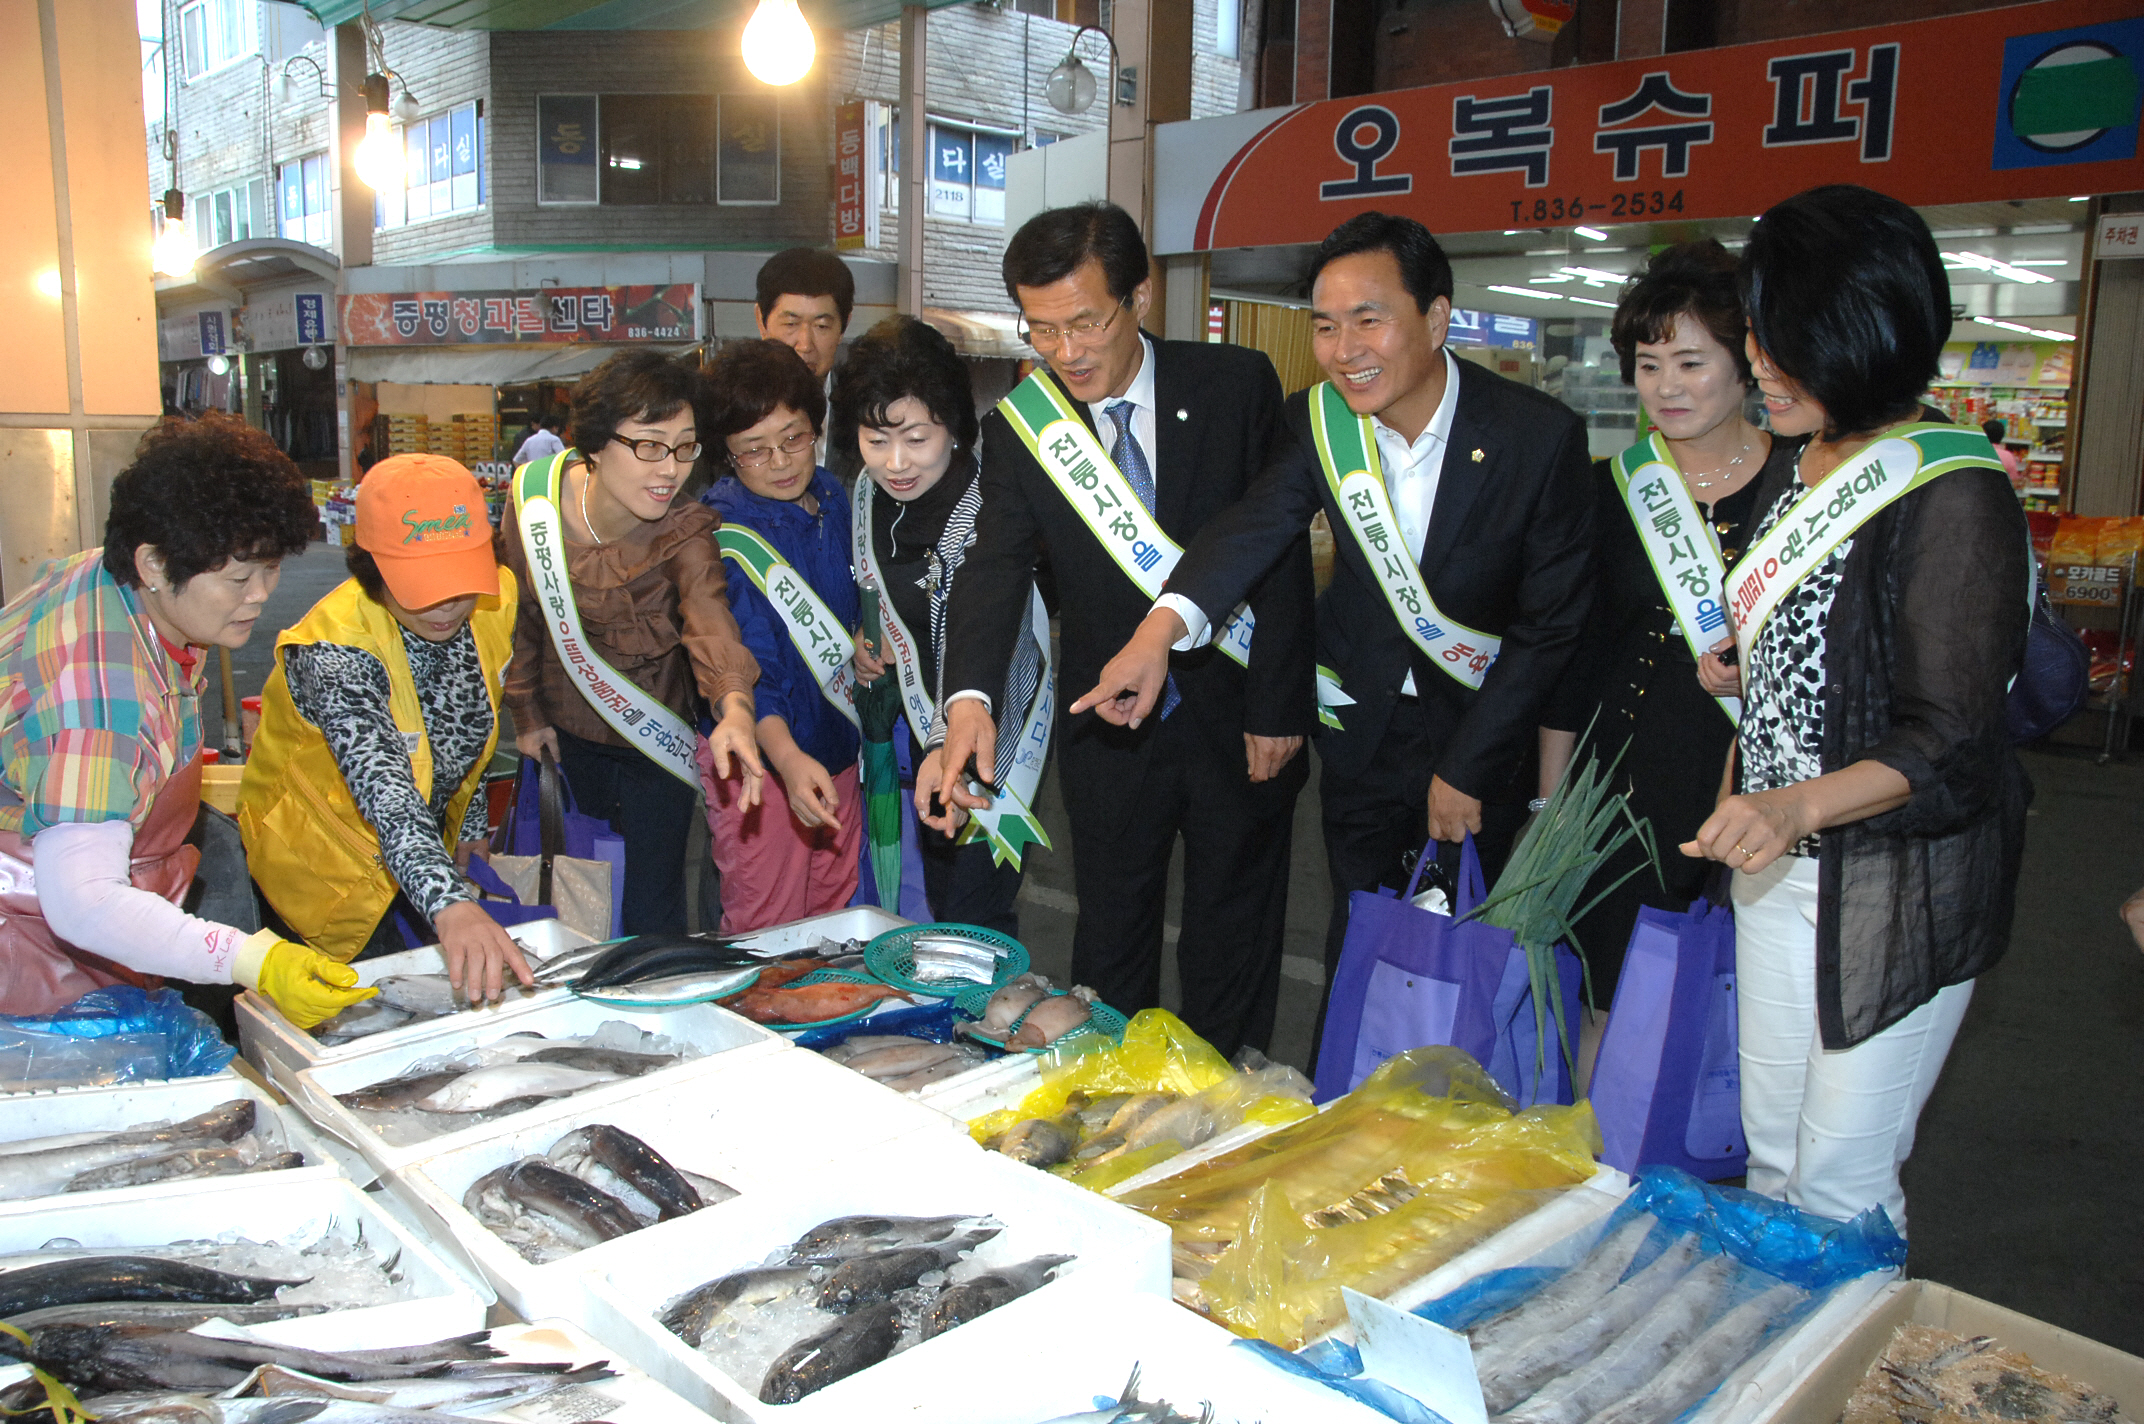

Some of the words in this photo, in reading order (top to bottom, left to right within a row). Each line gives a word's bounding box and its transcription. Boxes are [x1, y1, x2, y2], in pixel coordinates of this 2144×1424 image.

[1320, 42, 1900, 200] 오복슈퍼
[840, 128, 861, 234] 동백다방
[934, 188, 964, 202] 2118
[1510, 190, 1685, 223] T.836-2534
[2104, 226, 2139, 245] 주차권
[627, 326, 681, 339] 836-4424
[1048, 432, 1163, 572] 전통시장을
[1638, 477, 1727, 633] 전통시장을
[1348, 488, 1445, 641] 전통시장을
[1442, 642, 1496, 677] 애용
[2066, 586, 2111, 600] 6900
[213, 955, 227, 973] HK
